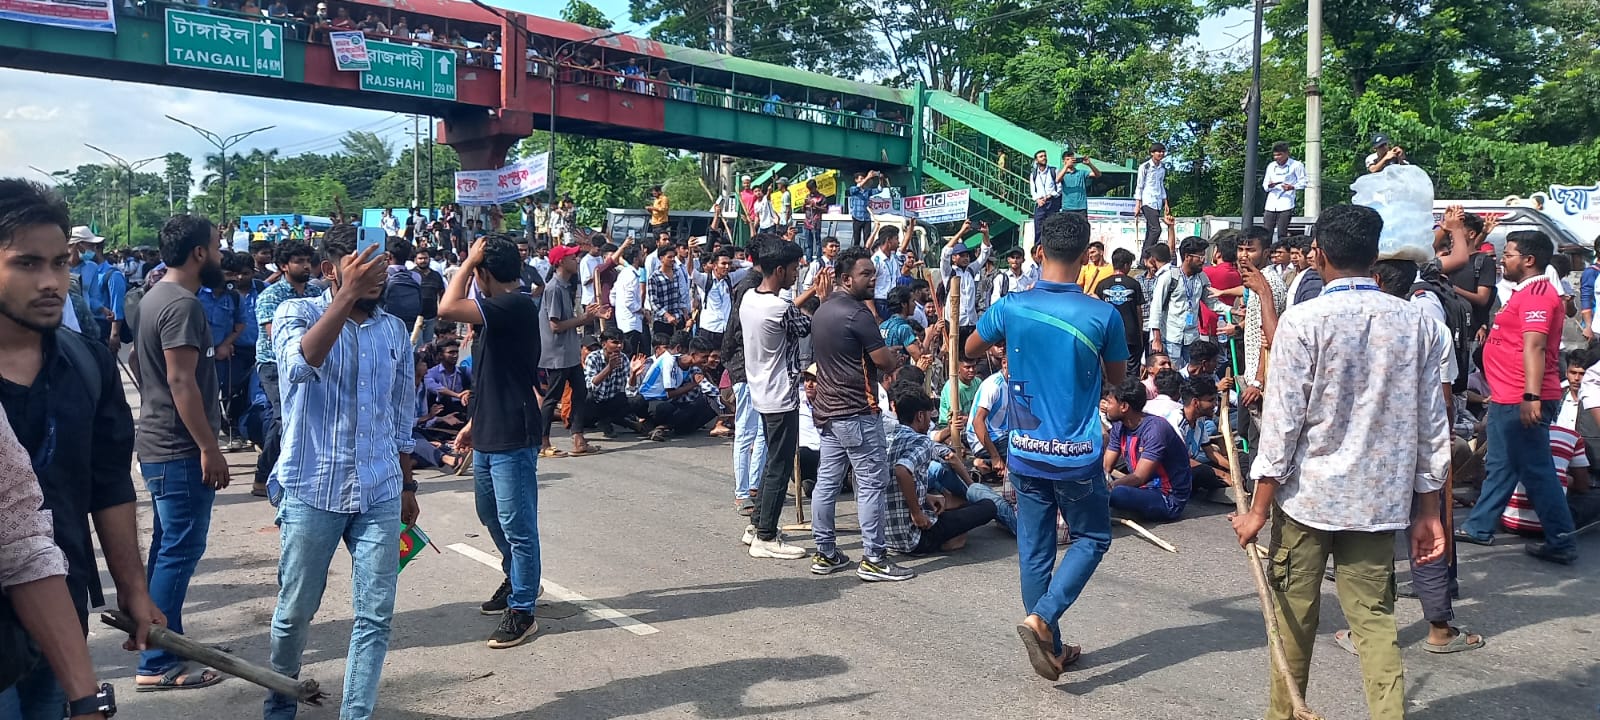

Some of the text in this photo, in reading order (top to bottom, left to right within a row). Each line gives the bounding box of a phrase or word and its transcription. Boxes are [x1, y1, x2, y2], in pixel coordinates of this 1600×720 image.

[171, 14, 250, 45] টাঙ্গাইল
[173, 47, 250, 68] TANGAIL
[257, 58, 280, 71] 64 KM
[368, 49, 424, 70] রাজশাহী
[366, 74, 425, 91] RAJSHAHI
[434, 83, 454, 94] 229 KM
[1551, 186, 1599, 215] জয়া
